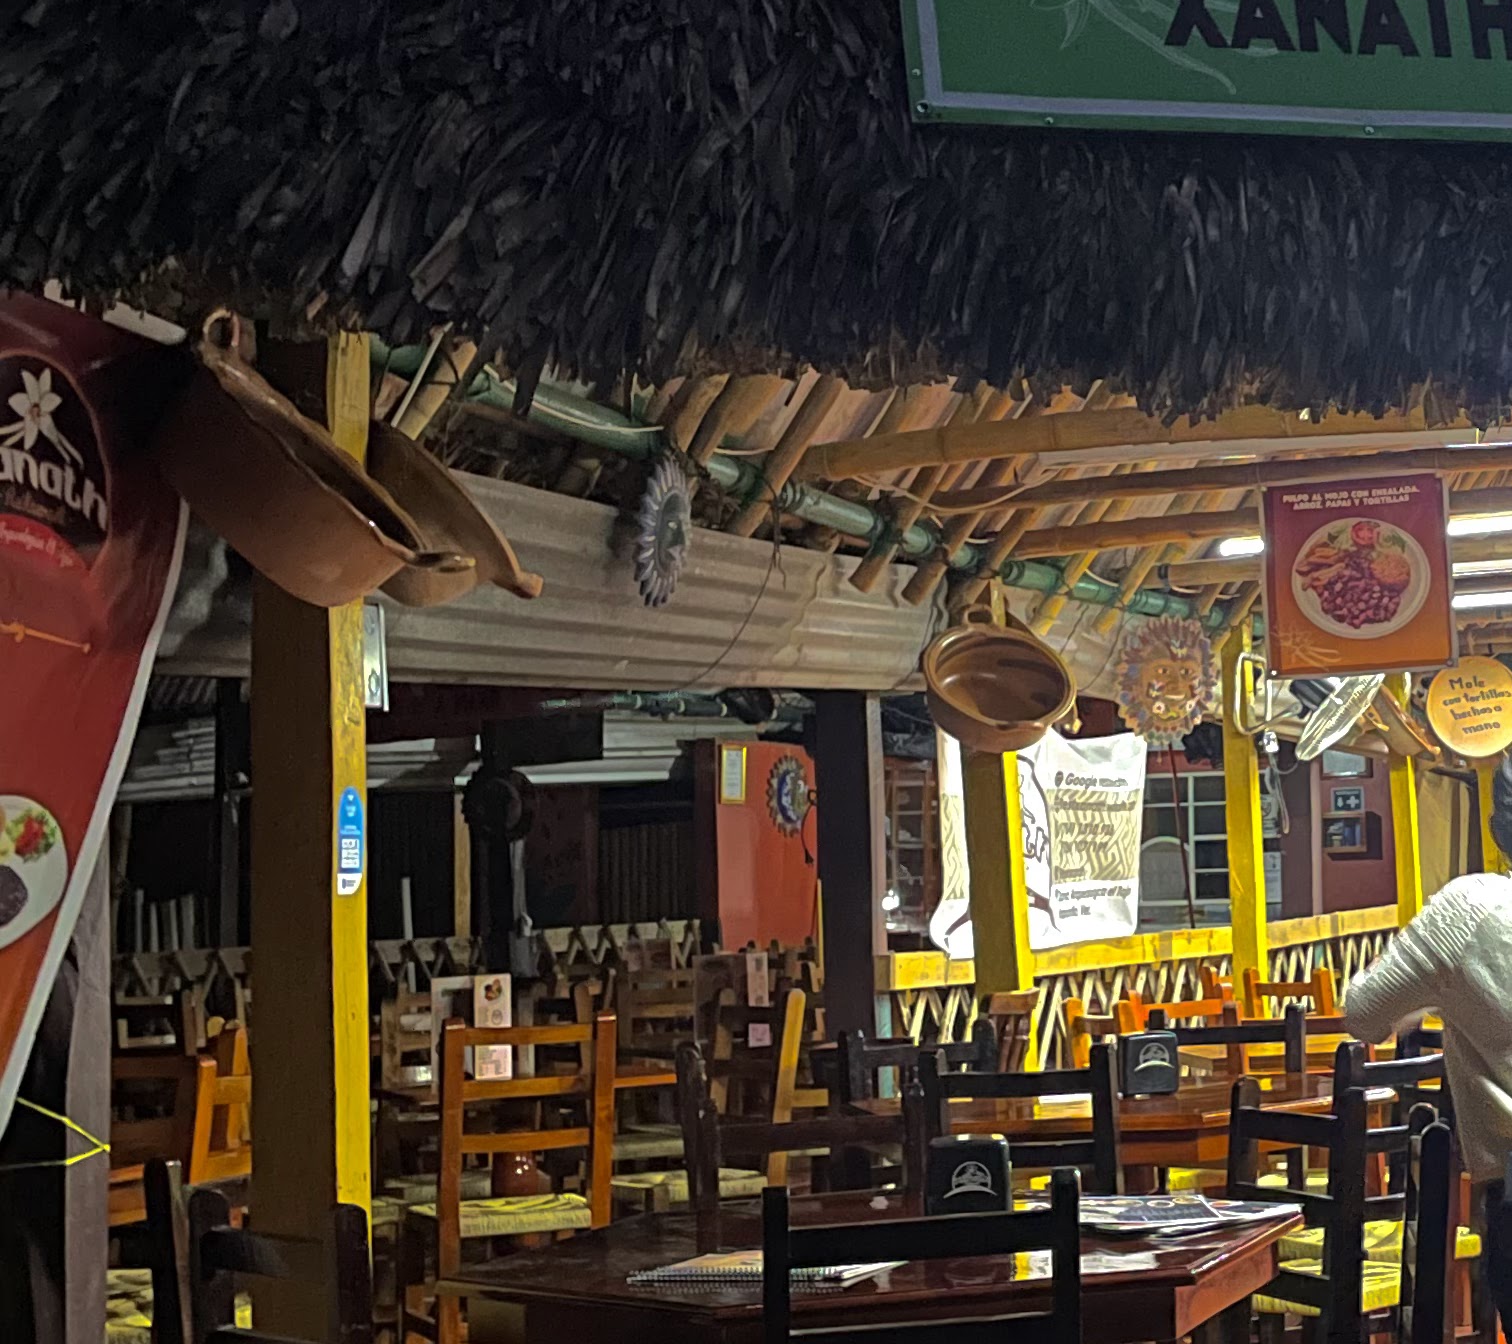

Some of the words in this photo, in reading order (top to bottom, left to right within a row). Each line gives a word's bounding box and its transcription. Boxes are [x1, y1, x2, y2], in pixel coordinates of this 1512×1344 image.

[1283, 493, 1309, 503] PULPO
[1311, 493, 1322, 501] AL
[1325, 491, 1349, 500] MOJO
[1448, 676, 1486, 690] Mole
[1442, 696, 1461, 706] con
[1463, 688, 1512, 703] tortillas
[1462, 721, 1501, 734] mano
[1065, 772, 1098, 789] Google
